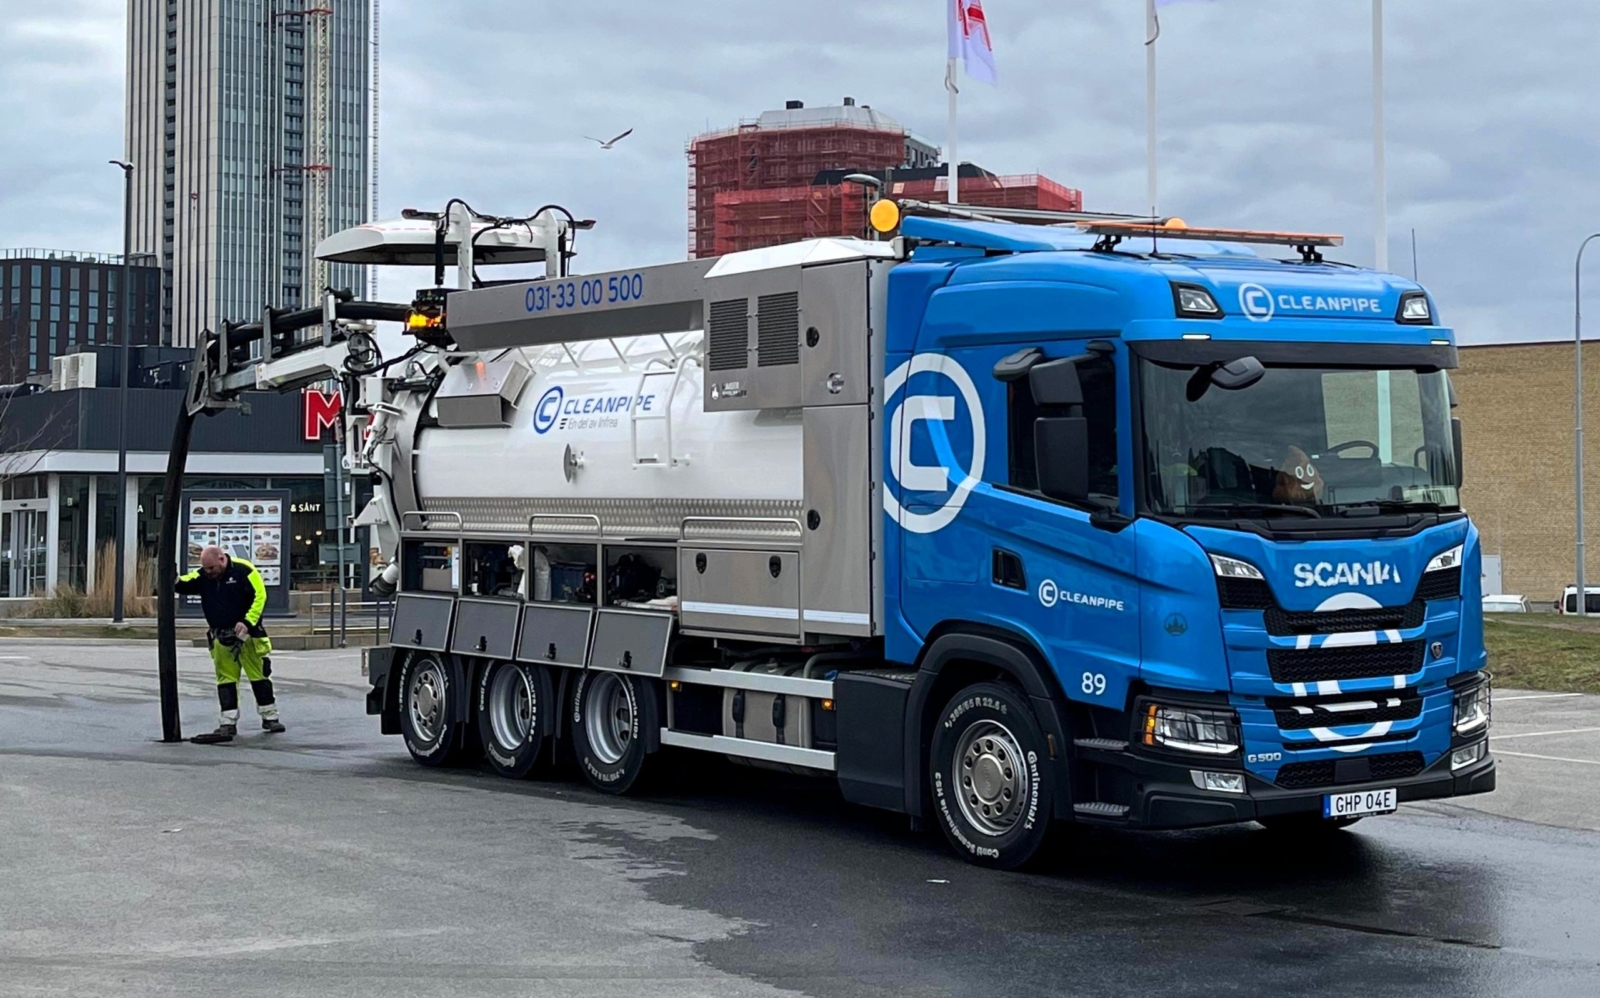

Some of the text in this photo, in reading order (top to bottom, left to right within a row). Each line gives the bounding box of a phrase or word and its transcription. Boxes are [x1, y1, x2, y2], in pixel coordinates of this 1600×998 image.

[525, 273, 643, 312] 031-33 00 500
[1278, 294, 1382, 313] CLEANPIPE
[563, 395, 655, 415] CLEANPIPE
[1293, 561, 1401, 588] SCANIA
[1060, 591, 1124, 611] CLEANPIPE
[1081, 671, 1107, 695] 89
[1336, 791, 1391, 813] GHP 04E
